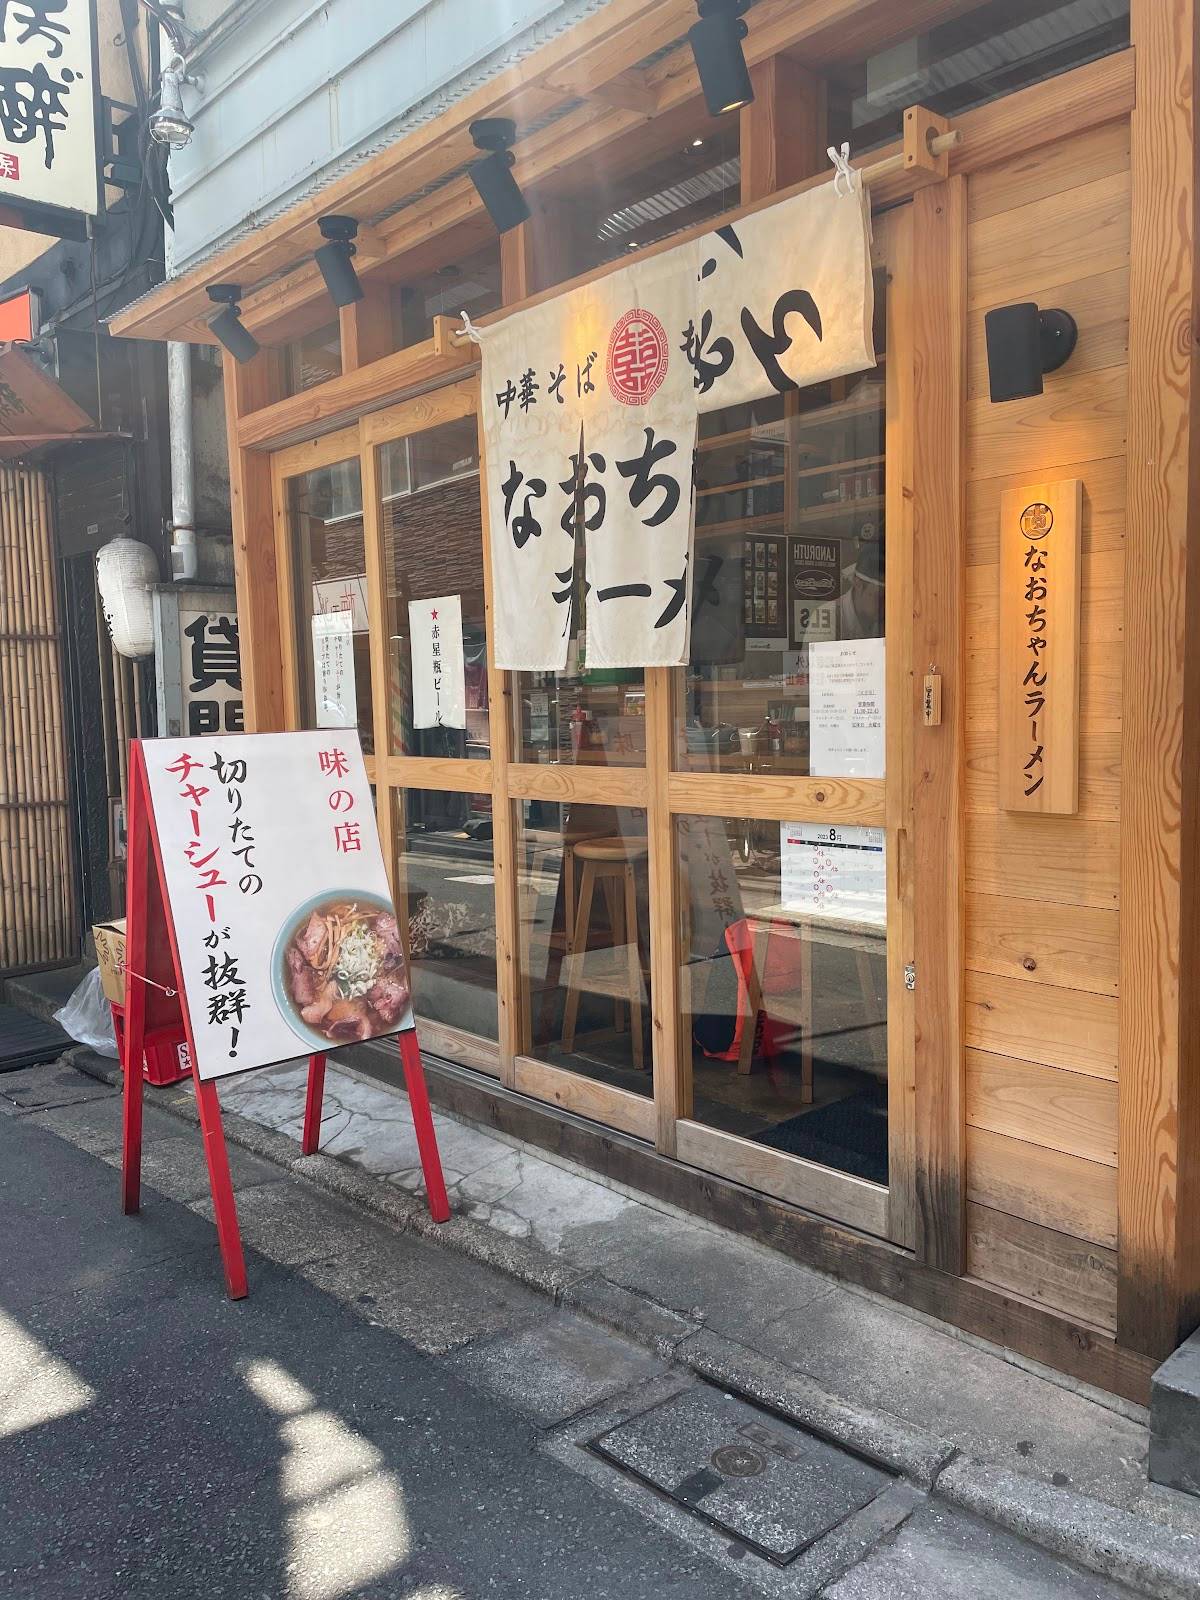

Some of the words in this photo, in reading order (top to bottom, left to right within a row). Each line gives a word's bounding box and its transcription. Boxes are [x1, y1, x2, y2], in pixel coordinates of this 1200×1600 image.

[496, 351, 598, 420] 中華そば
[431, 624, 444, 726] 赤星瓶ビール
[1023, 545, 1049, 797] なおちゃんラーメン
[210, 751, 263, 896] 切りたての
[318, 748, 361, 853] 味の店
[164, 752, 252, 1058] チャーシューが抜群！
